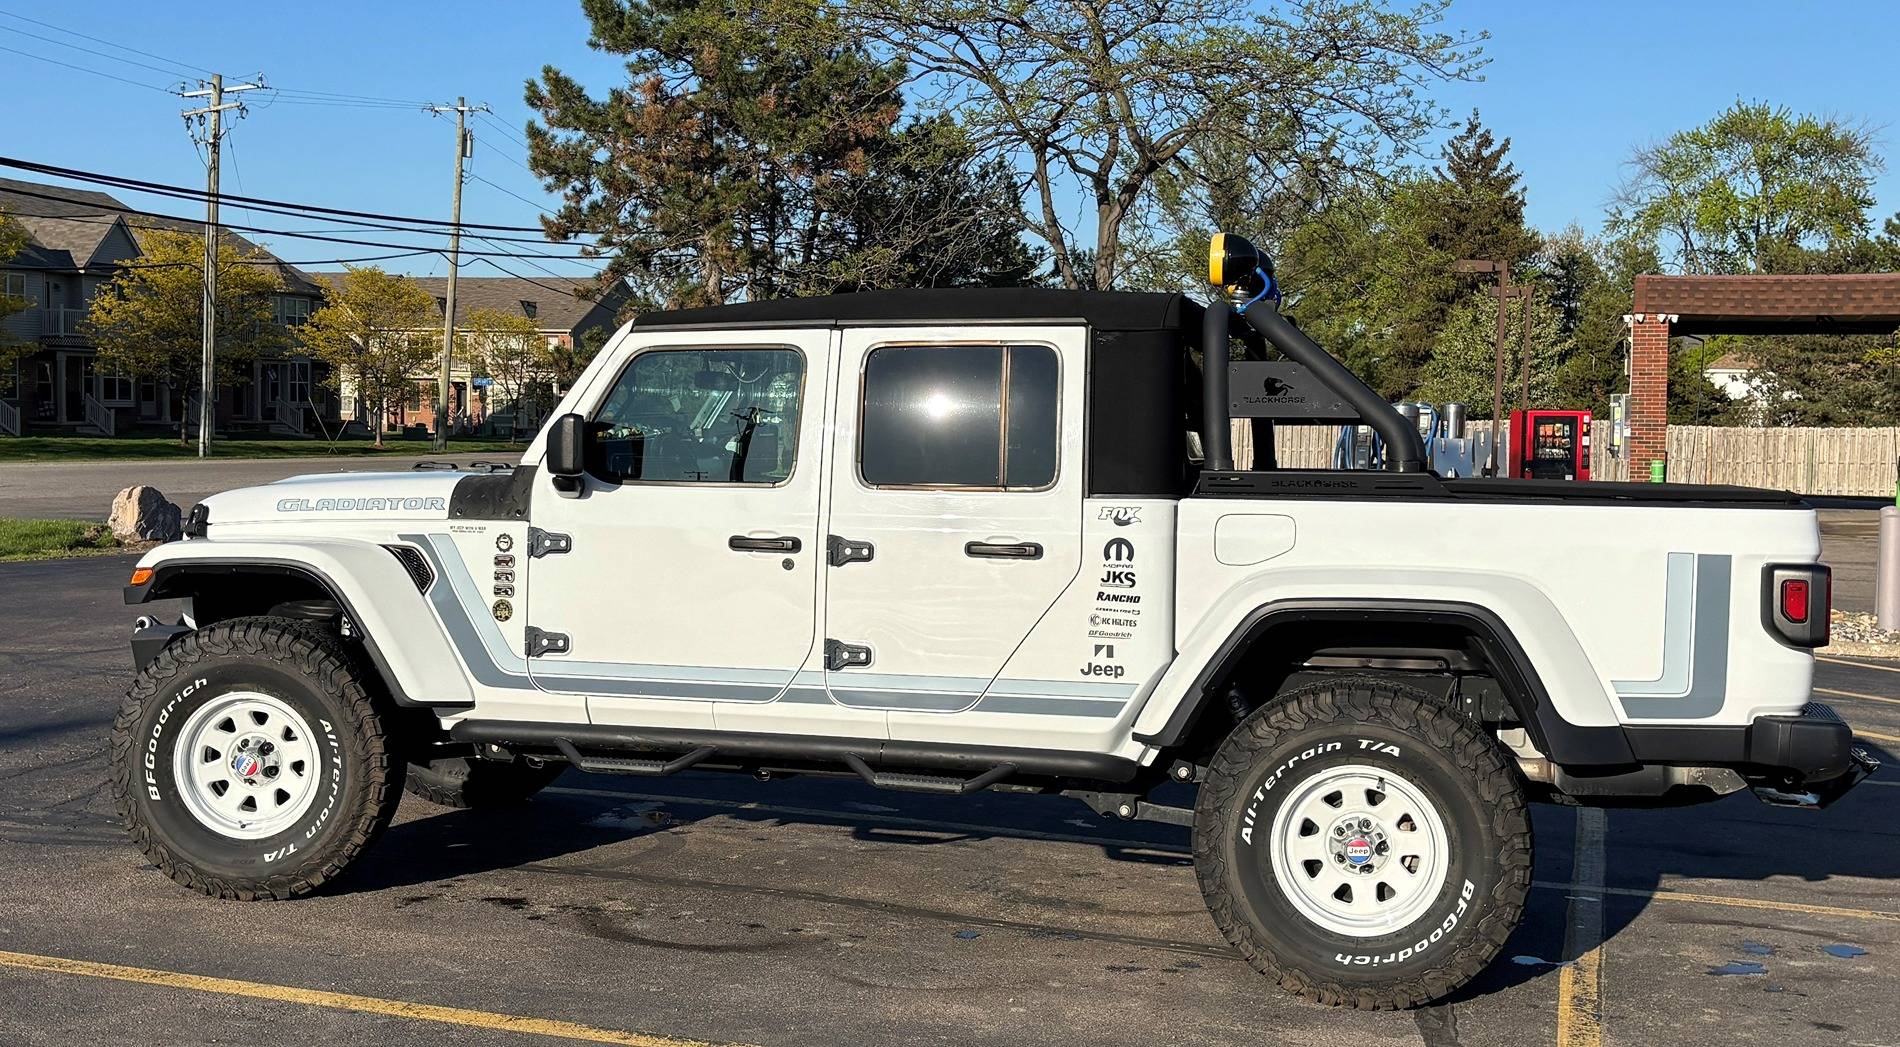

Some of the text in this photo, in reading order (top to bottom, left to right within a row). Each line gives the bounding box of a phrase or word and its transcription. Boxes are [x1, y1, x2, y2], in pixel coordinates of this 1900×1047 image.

[277, 497, 446, 512] GLADIATOR
[1098, 506, 1142, 526] FOX
[1100, 570, 1136, 588] JKS
[1101, 617, 1111, 625] KC
[1088, 630, 1133, 639] BFGoodrich
[1080, 662, 1125, 679] Jeep
[145, 677, 208, 801] BFGoodrich
[263, 718, 342, 864] All-Terrain T/A
[1240, 738, 1401, 846] All-Terrain T/A
[1348, 847, 1369, 855] Jeep
[1334, 878, 1476, 968] BFGoodrich
